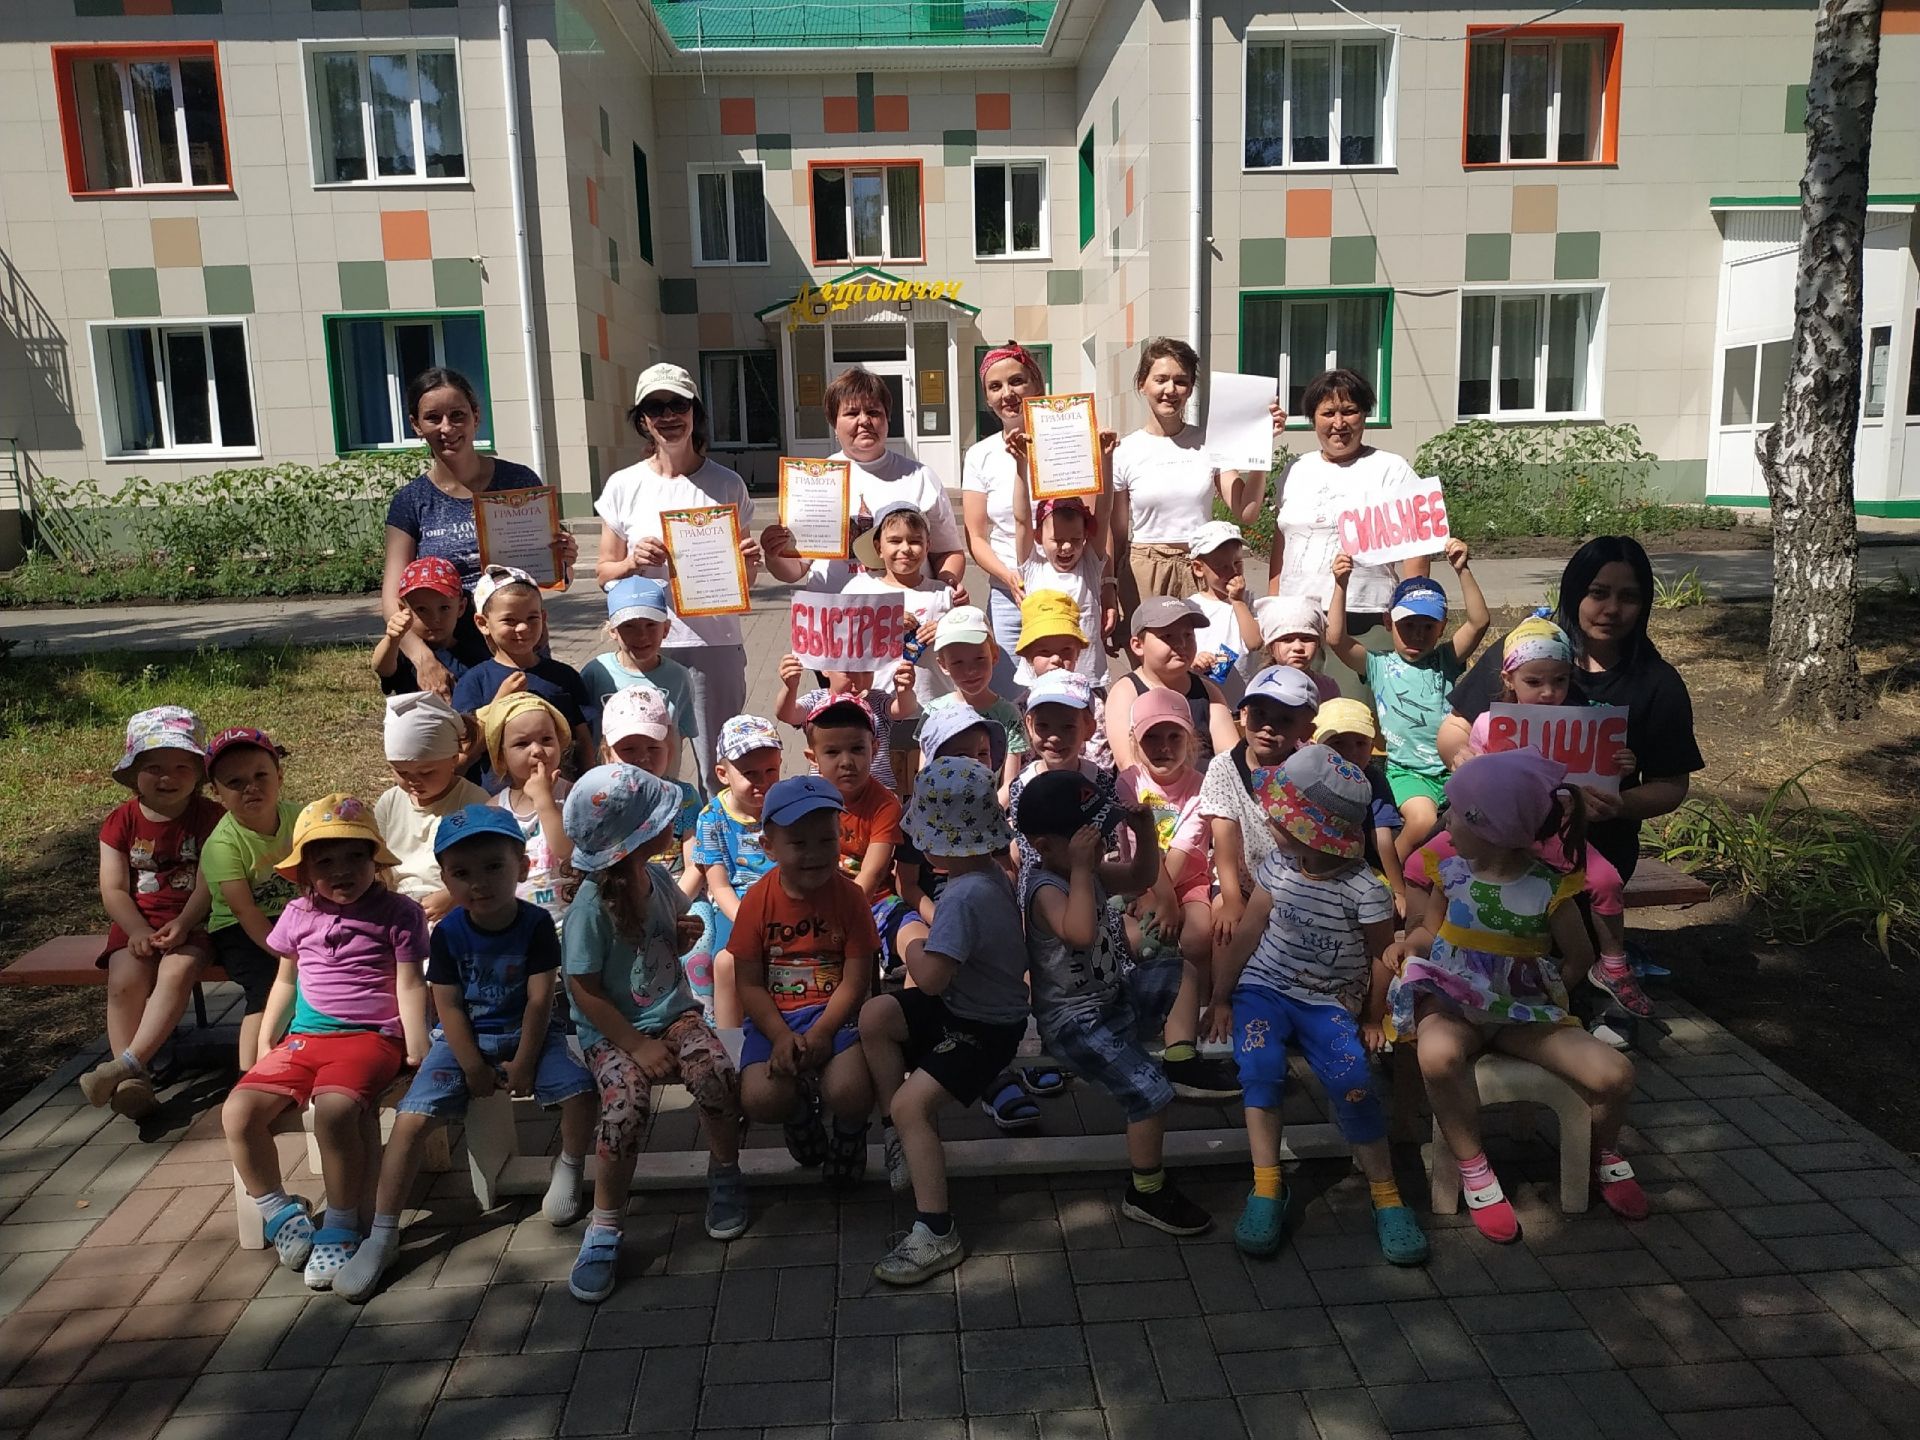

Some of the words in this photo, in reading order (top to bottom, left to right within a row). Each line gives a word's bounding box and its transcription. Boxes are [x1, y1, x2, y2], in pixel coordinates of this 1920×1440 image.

[1040, 412, 1083, 423] ГРАМОТА
[795, 476, 837, 486] ГРАМОТА
[493, 507, 543, 520] ГРАМОТА
[1337, 490, 1449, 556] СИЛЬНЕЕ
[679, 526, 725, 538] ГРАМОТА
[792, 603, 904, 659] БЫСТРЕЕ
